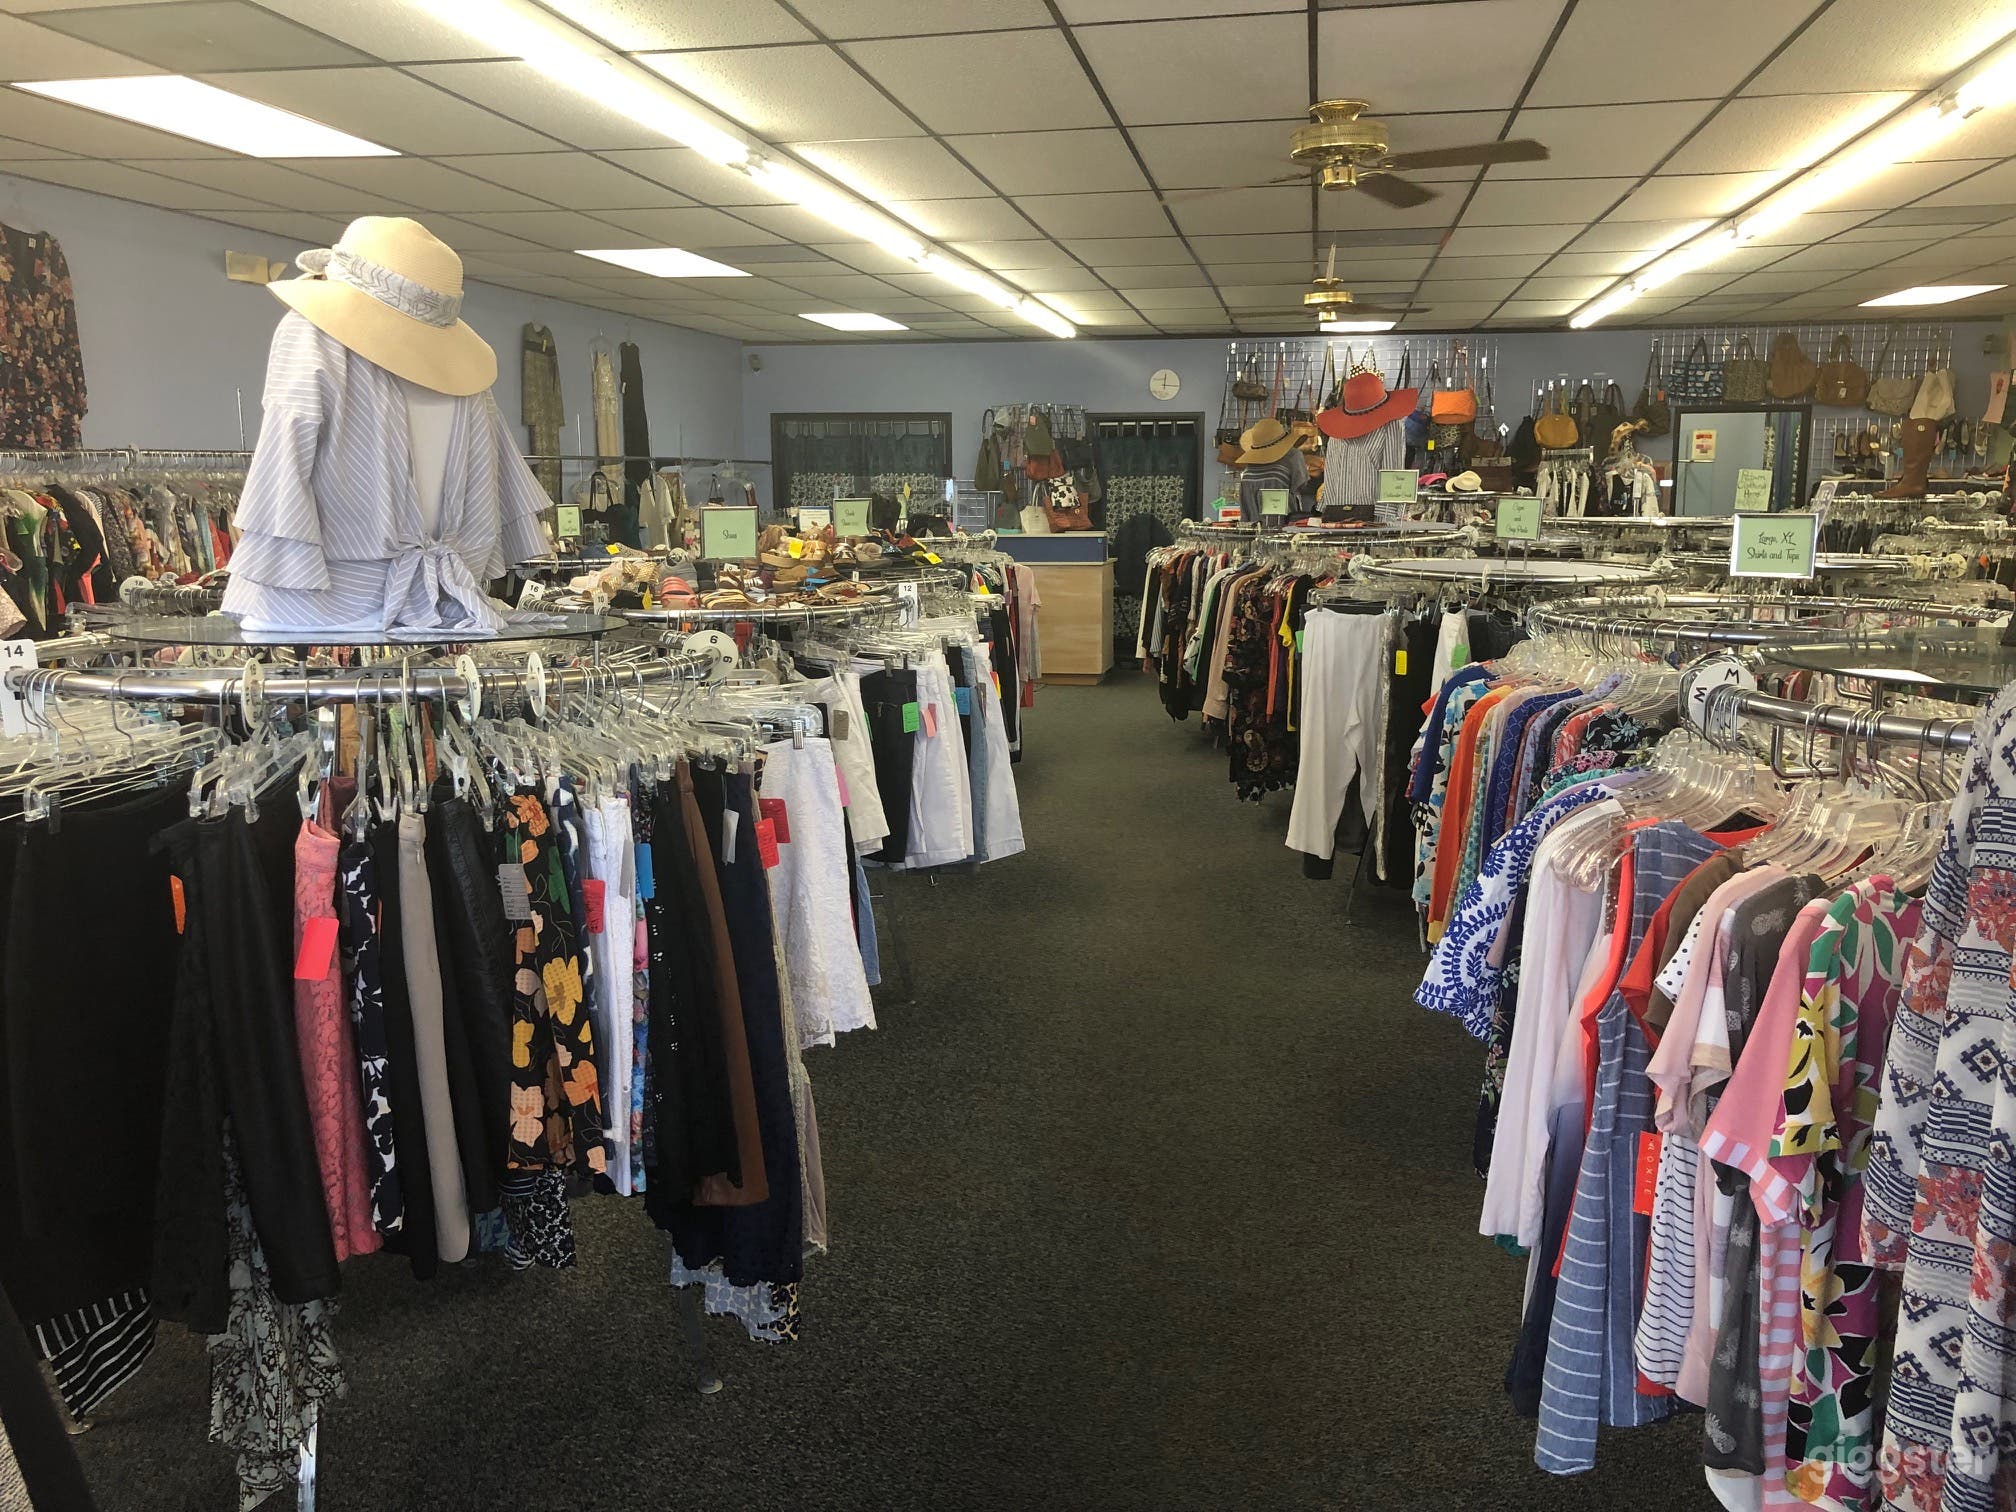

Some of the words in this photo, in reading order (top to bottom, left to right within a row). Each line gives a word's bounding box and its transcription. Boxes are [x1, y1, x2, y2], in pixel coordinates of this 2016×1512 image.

[1781, 531, 1797, 546] XL
[1746, 546, 1768, 560] Shirts
[1769, 549, 1783, 560] and
[1785, 548, 1800, 564] Tops
[529, 584, 539, 593] 16
[597, 595, 605, 603] 10
[709, 635, 719, 644] 6
[4, 645, 24, 658] 14
[1724, 667, 1740, 684] M
